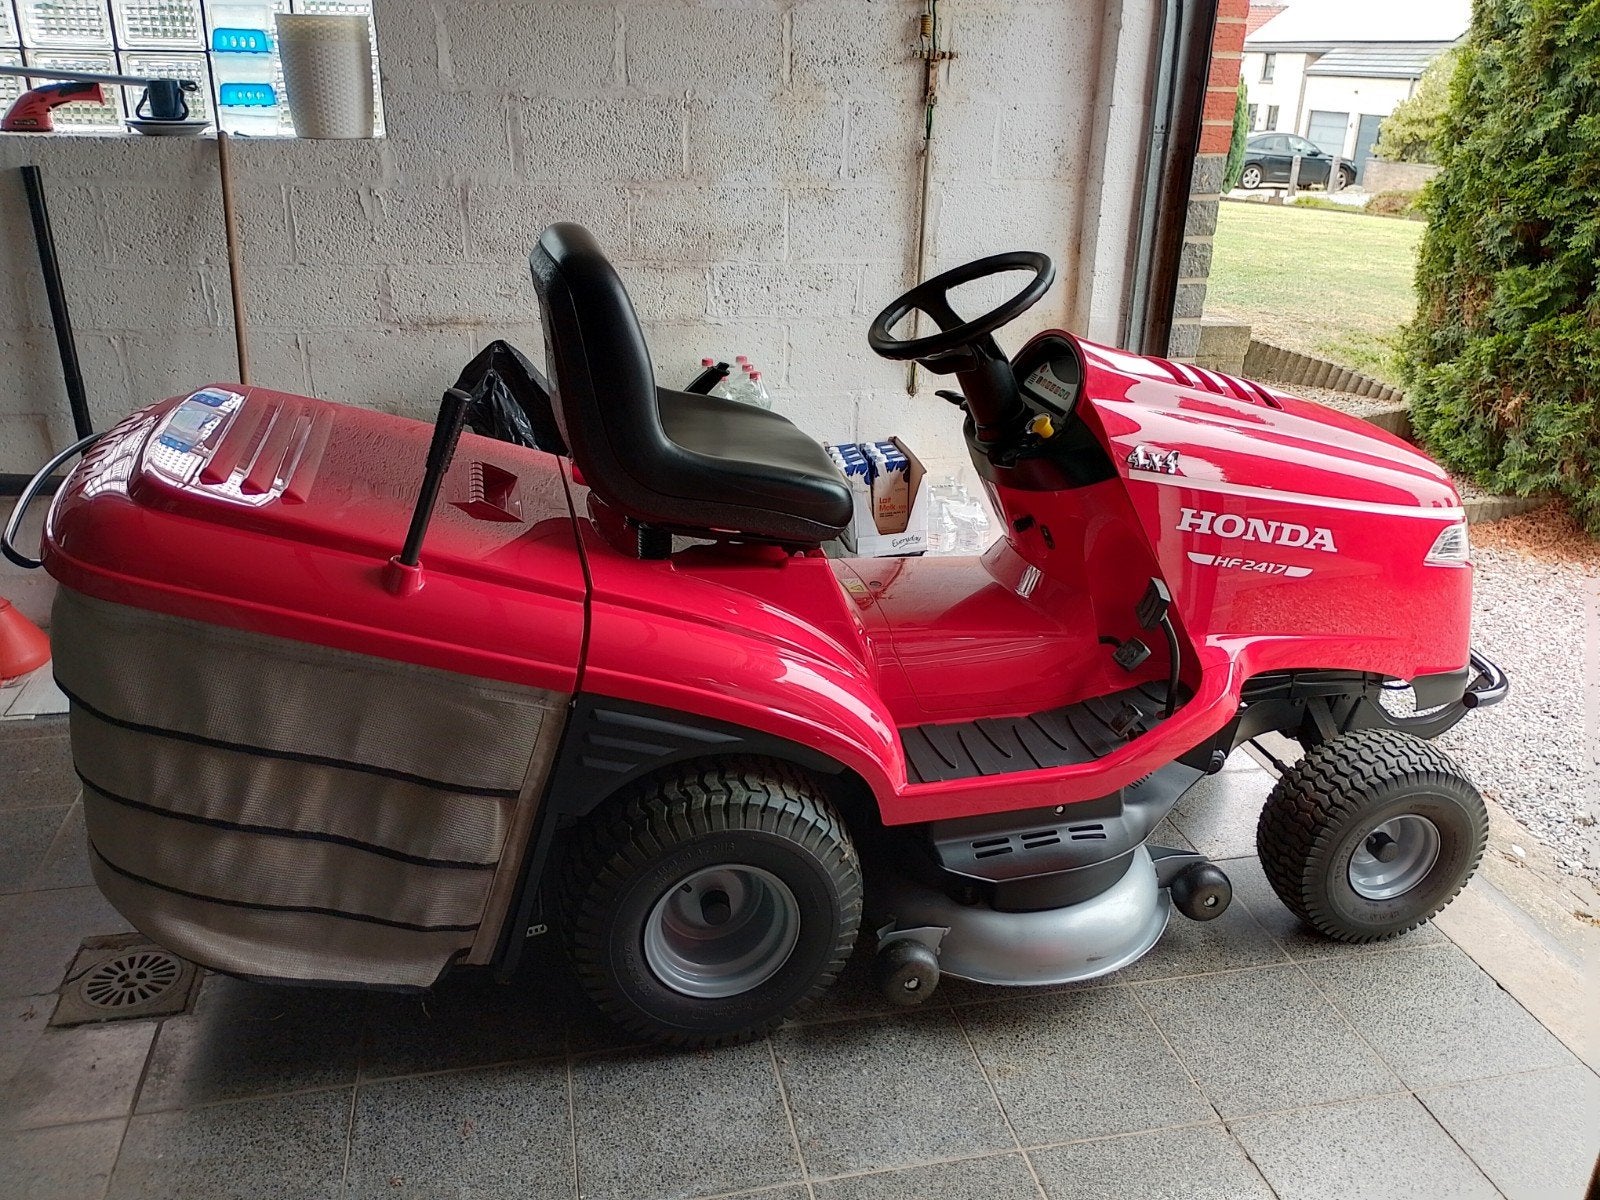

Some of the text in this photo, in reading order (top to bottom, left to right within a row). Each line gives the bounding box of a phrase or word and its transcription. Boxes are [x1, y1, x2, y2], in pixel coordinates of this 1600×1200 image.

[1127, 445, 1179, 474] 4x4
[892, 535, 921, 548] Everyday
[1175, 507, 1338, 553] HONDA
